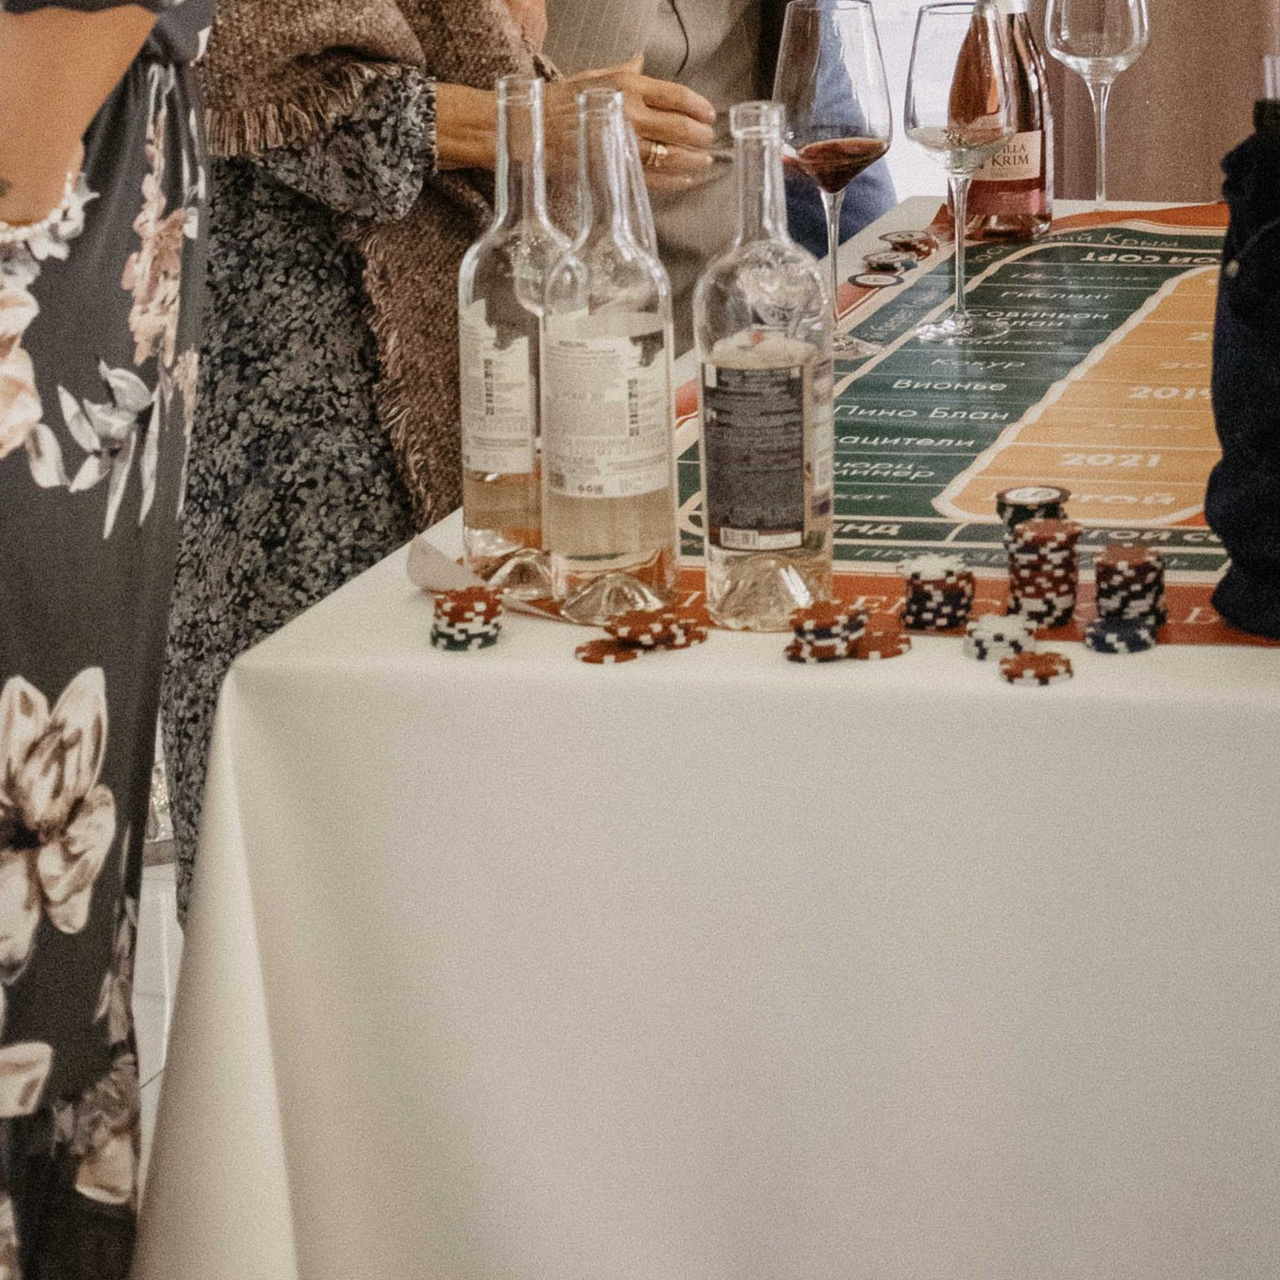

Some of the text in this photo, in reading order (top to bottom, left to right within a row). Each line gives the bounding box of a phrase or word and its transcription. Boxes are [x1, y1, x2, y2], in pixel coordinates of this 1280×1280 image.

[991, 154, 1029, 168] KRIM
[1102, 233, 1179, 248] Крым
[892, 379, 1007, 390] Вионье
[833, 404, 1010, 421] Пино Блан
[1058, 452, 1162, 468] 2021
